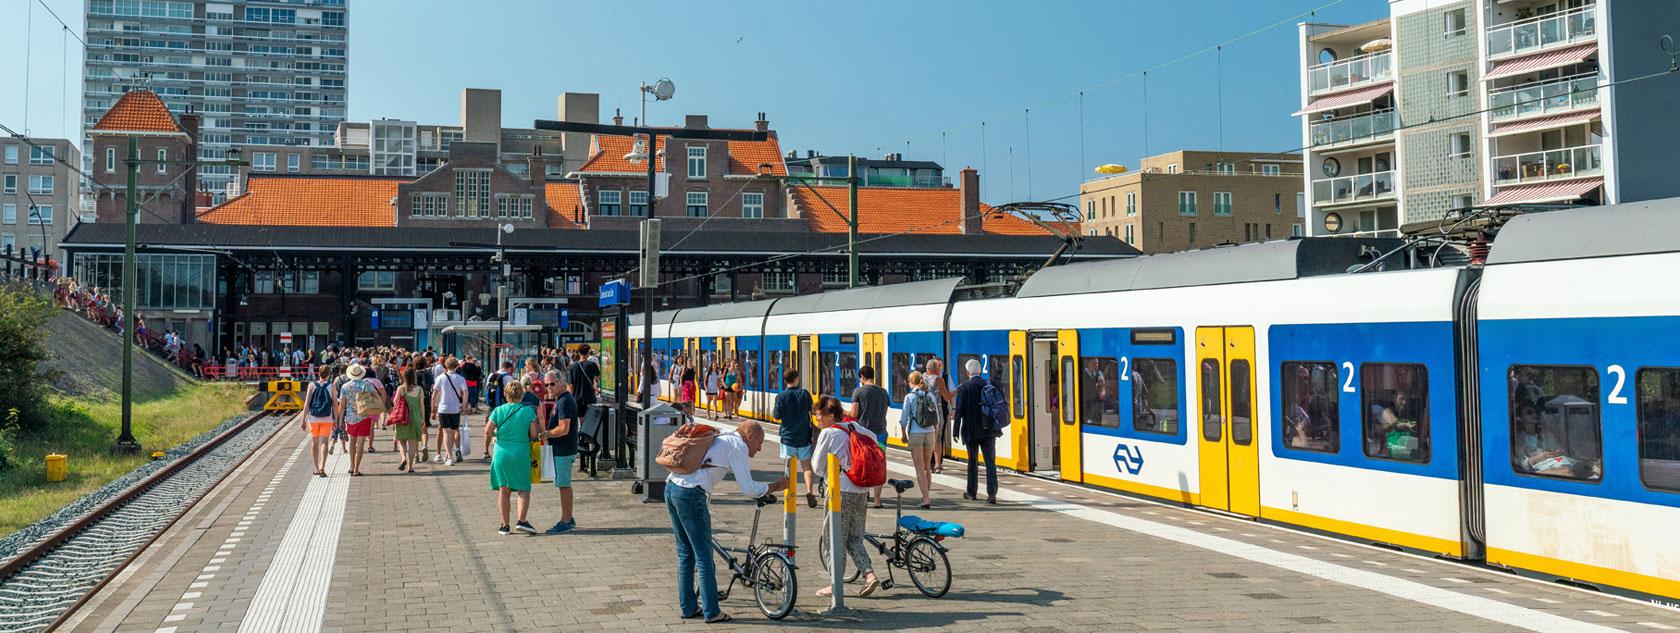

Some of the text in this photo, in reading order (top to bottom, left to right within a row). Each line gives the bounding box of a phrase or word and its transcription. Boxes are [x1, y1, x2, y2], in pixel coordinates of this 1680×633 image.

[835, 351, 840, 367] 2
[910, 353, 916, 371] 2
[982, 354, 988, 374] 2
[1120, 357, 1128, 381] 2
[1343, 361, 1356, 393] 2
[1608, 364, 1627, 404] 2
